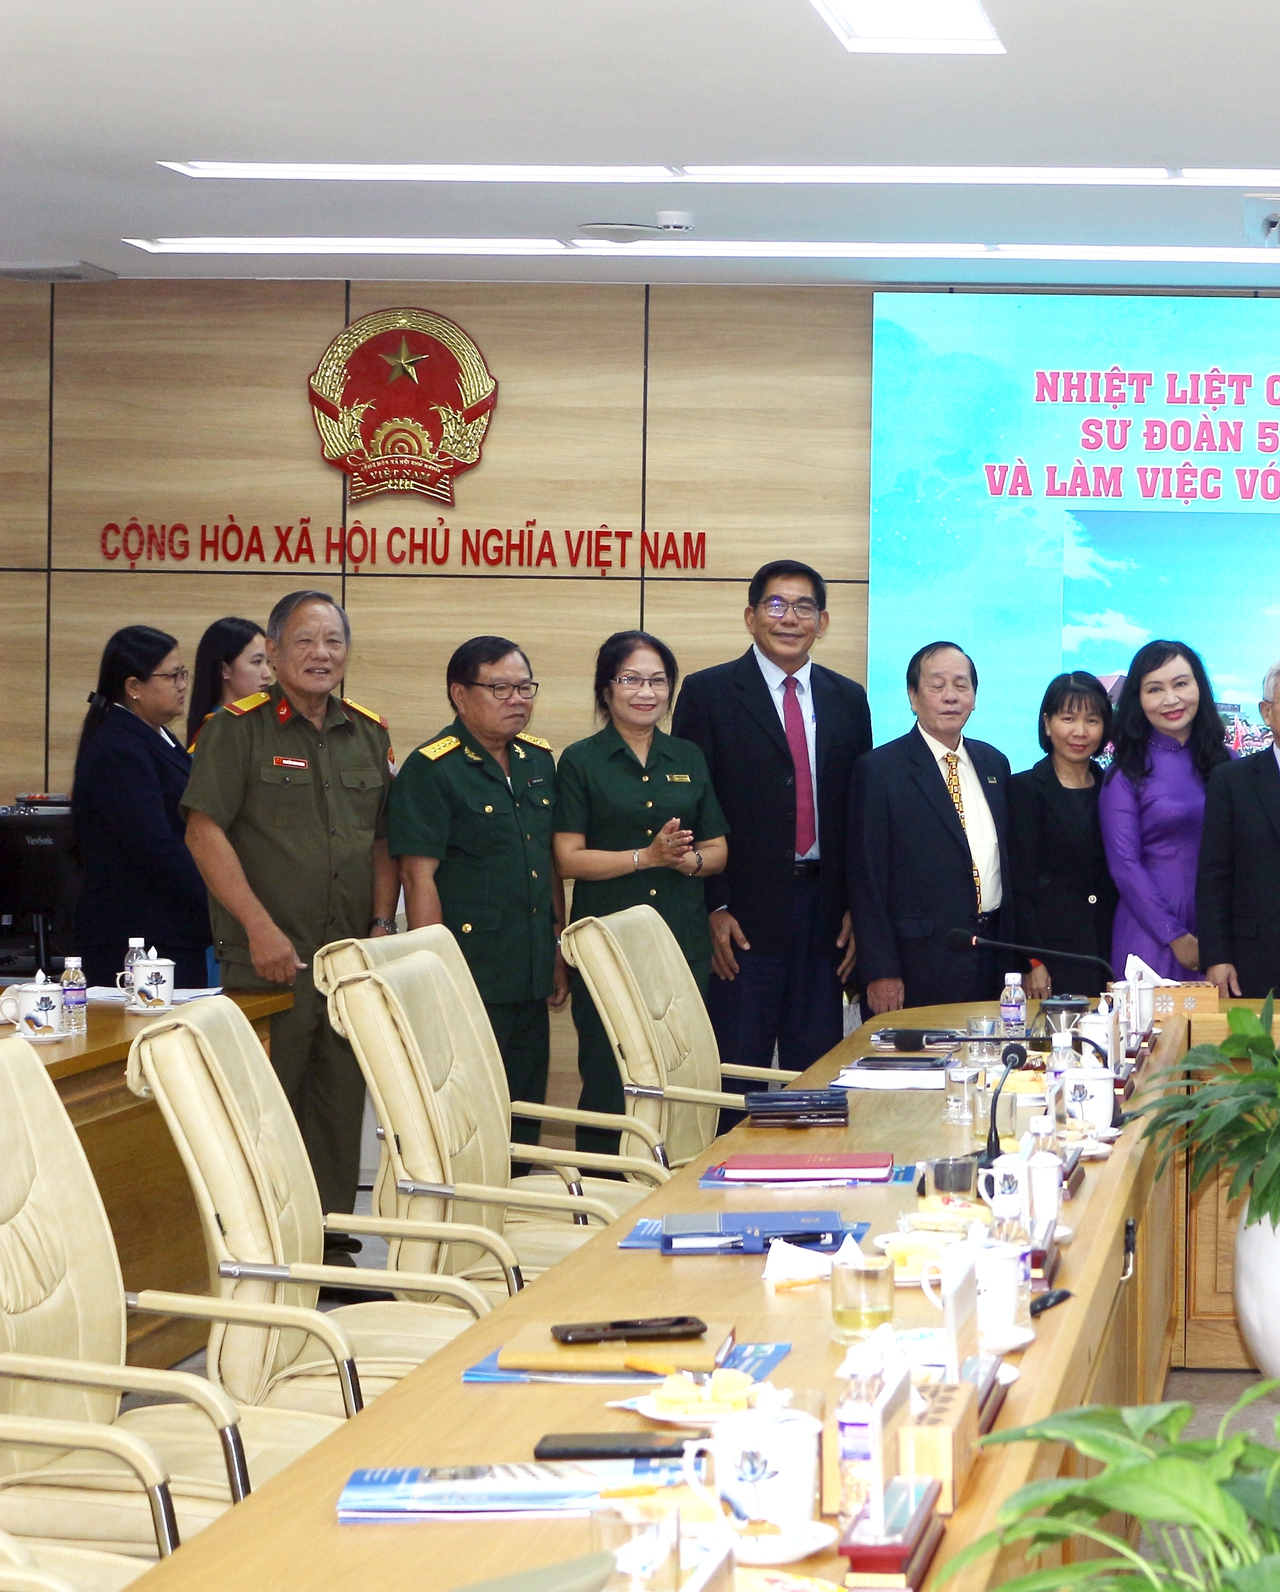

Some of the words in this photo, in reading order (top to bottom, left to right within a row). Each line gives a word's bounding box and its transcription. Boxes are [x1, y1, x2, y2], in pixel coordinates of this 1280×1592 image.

[1035, 366, 1153, 410] NHIỆT
[1166, 368, 1252, 411] LIỆT
[1081, 418, 1132, 452] SƯ
[1143, 413, 1244, 453] ĐOÀN
[1257, 421, 1280, 454] 5
[985, 458, 1033, 497] VÀ
[1045, 459, 1124, 499] LÀM
[1137, 461, 1222, 506] VIỆC
[101, 517, 190, 569] CỘNG
[200, 514, 266, 562] HÒA
[273, 516, 316, 563] XÃ
[325, 520, 377, 573] HỘI
[386, 517, 450, 565] CHỦ
[461, 518, 558, 567] NGHĨA
[564, 524, 633, 576] VIỆT
[640, 531, 706, 569] NAM
